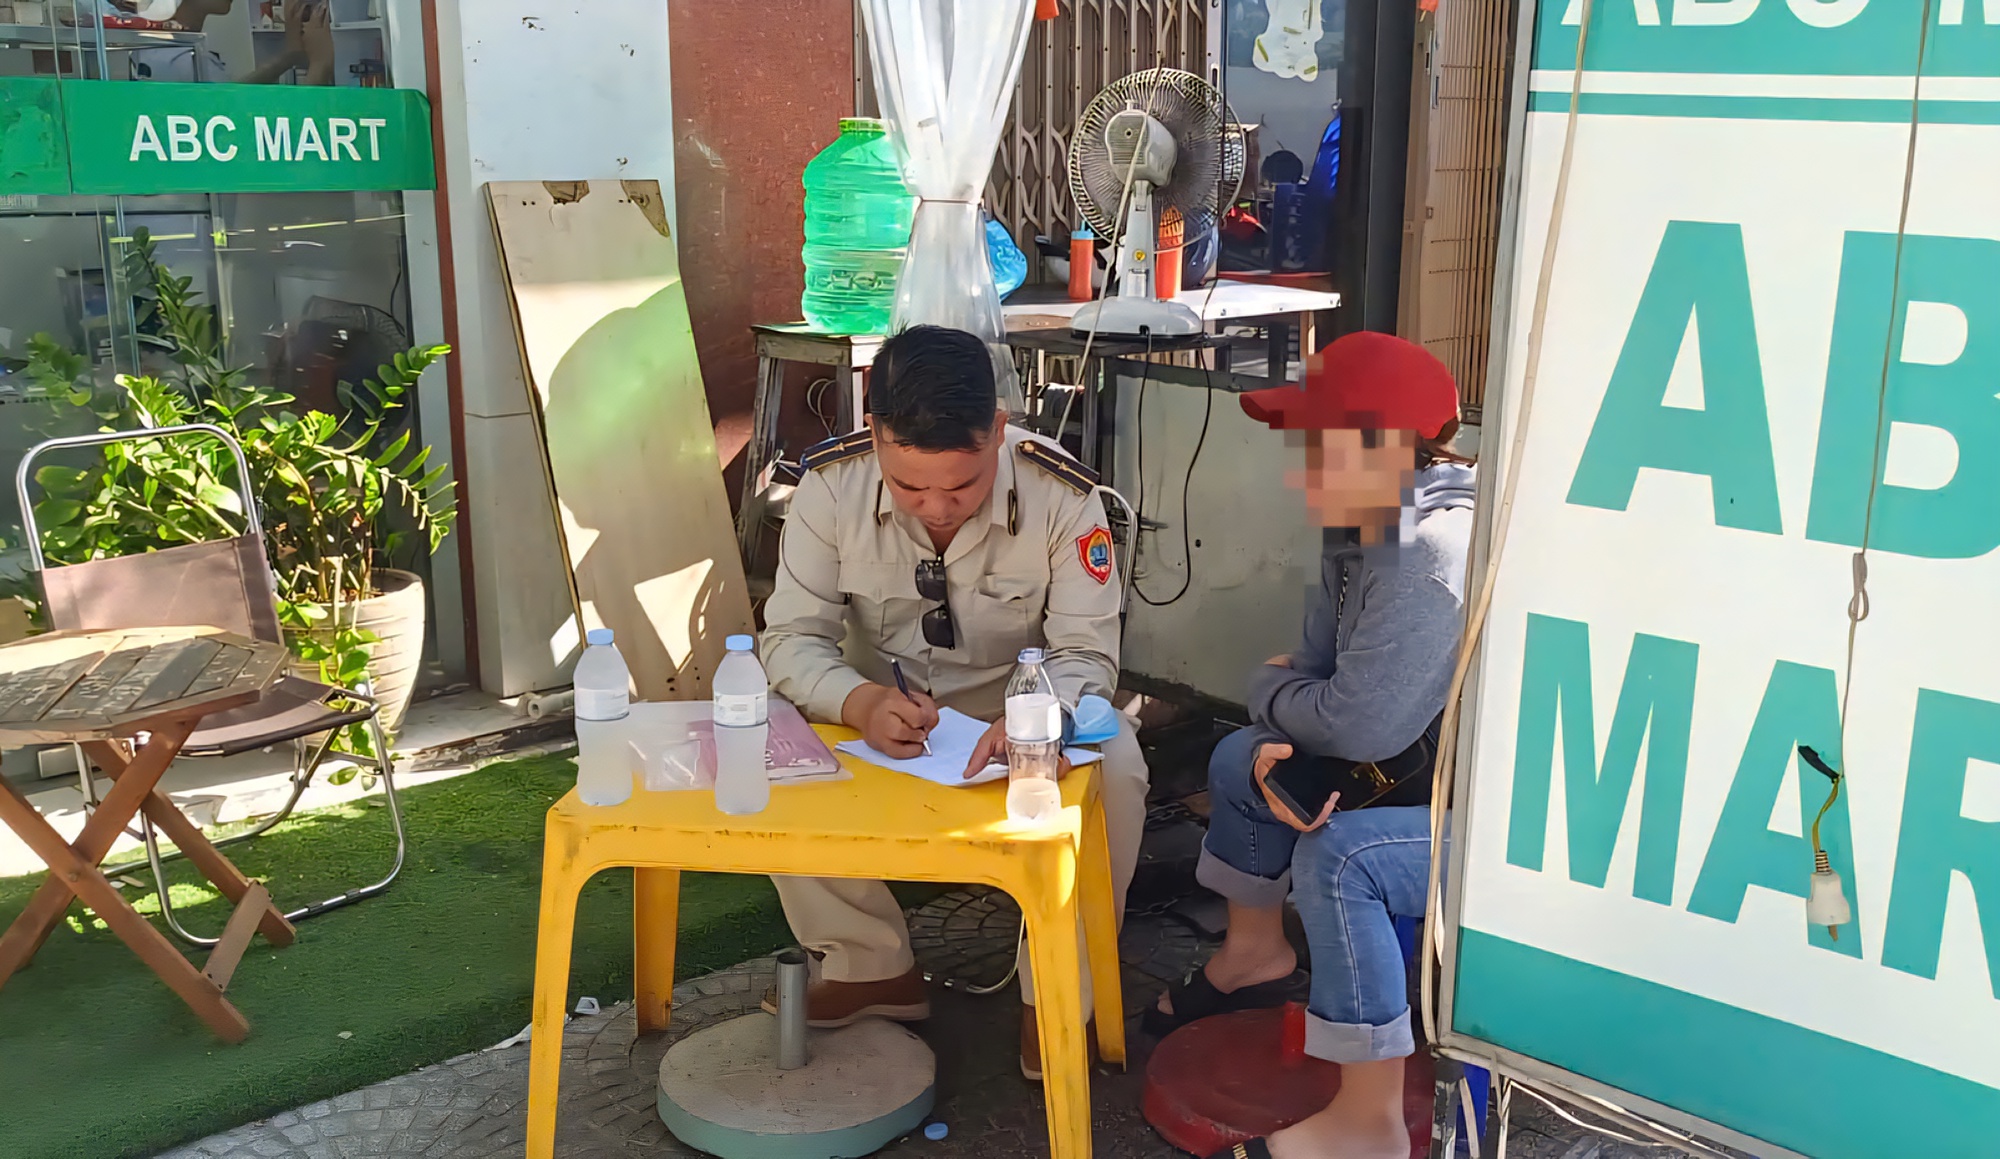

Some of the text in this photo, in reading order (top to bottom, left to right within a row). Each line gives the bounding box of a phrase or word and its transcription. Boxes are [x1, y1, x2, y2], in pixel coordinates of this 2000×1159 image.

[129, 115, 387, 162] ABC MART
[1566, 220, 2000, 559] AB
[1506, 612, 2000, 1000] MAR
